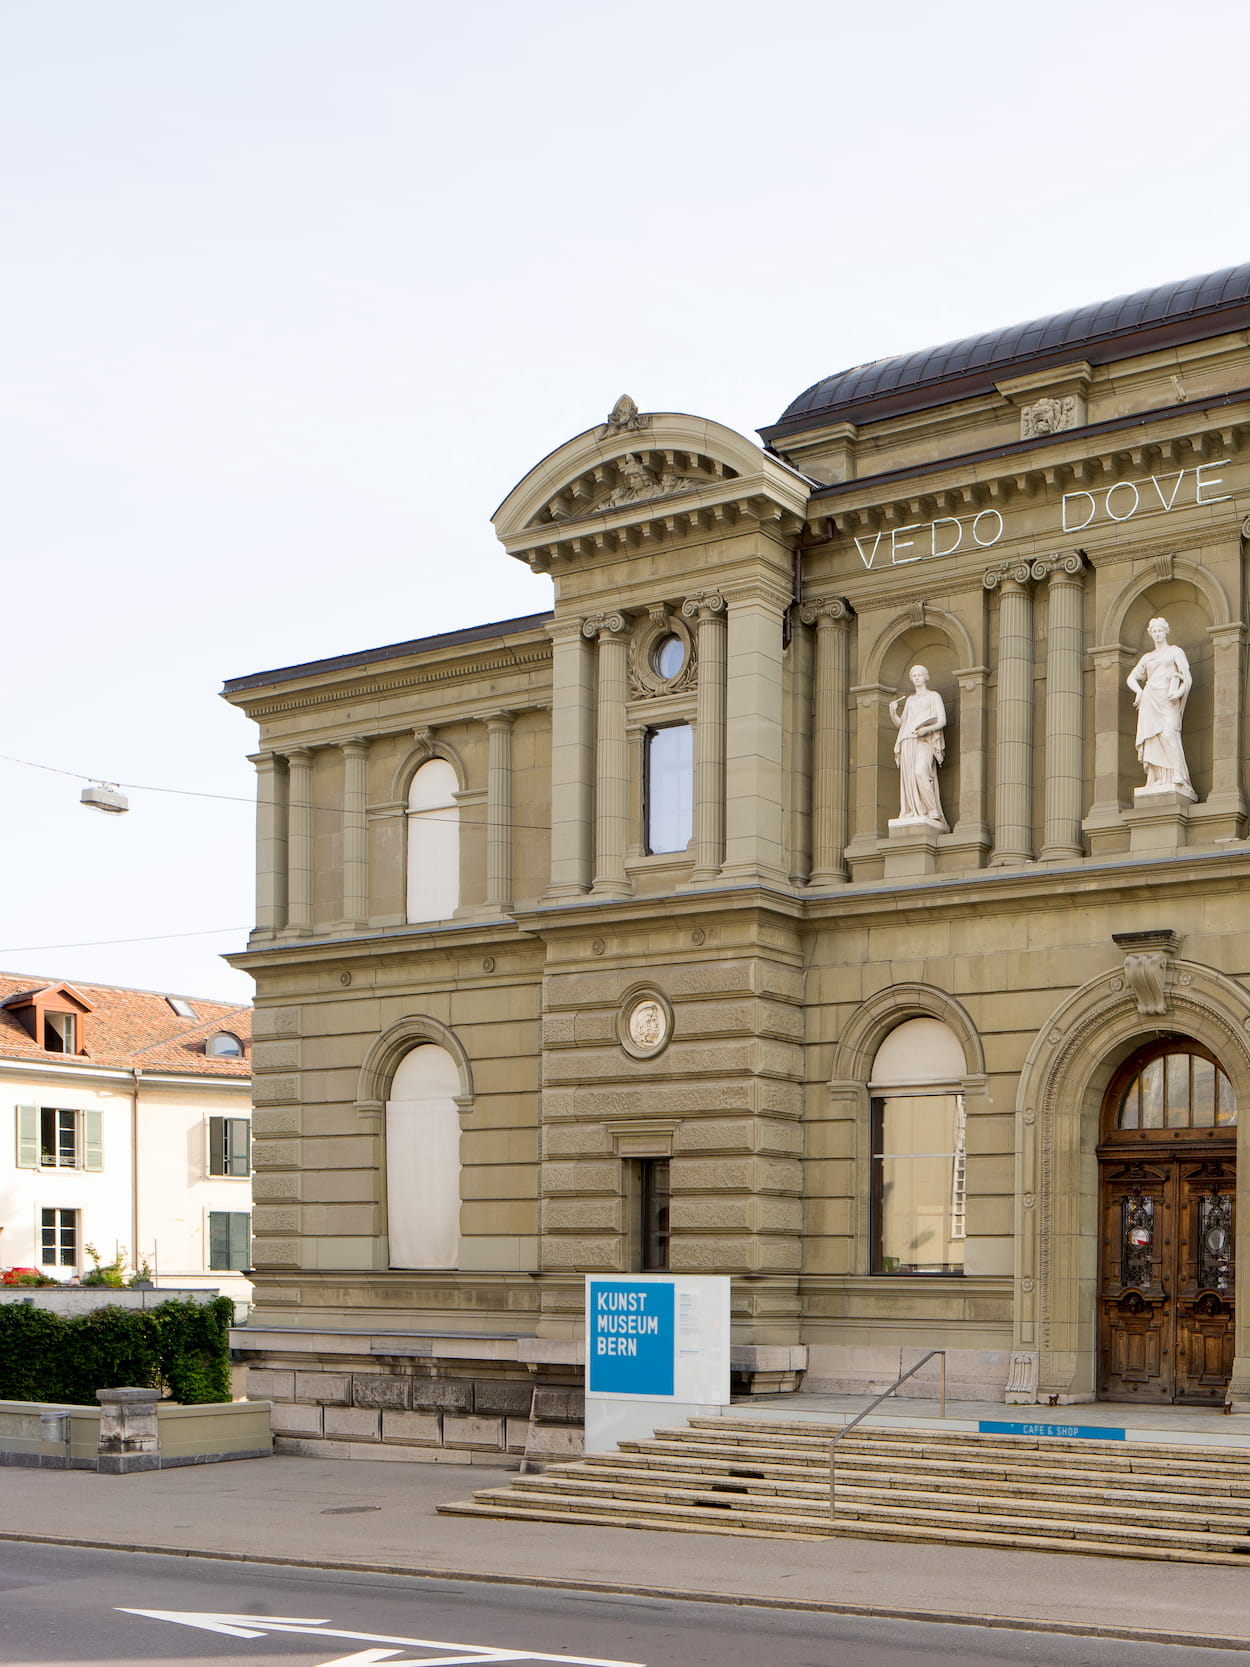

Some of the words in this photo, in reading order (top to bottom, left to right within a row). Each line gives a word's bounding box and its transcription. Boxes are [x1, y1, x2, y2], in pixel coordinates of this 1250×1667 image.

[854, 509, 1003, 569] VEDO
[1062, 458, 1233, 533] DOVE
[597, 1292, 647, 1311] KUNST
[597, 1314, 658, 1335] MUSEUM
[597, 1336, 637, 1356] BERN
[1023, 1424, 1045, 1435] CAFE
[1047, 1426, 1053, 1436] &
[1056, 1427, 1079, 1437] SHOP
